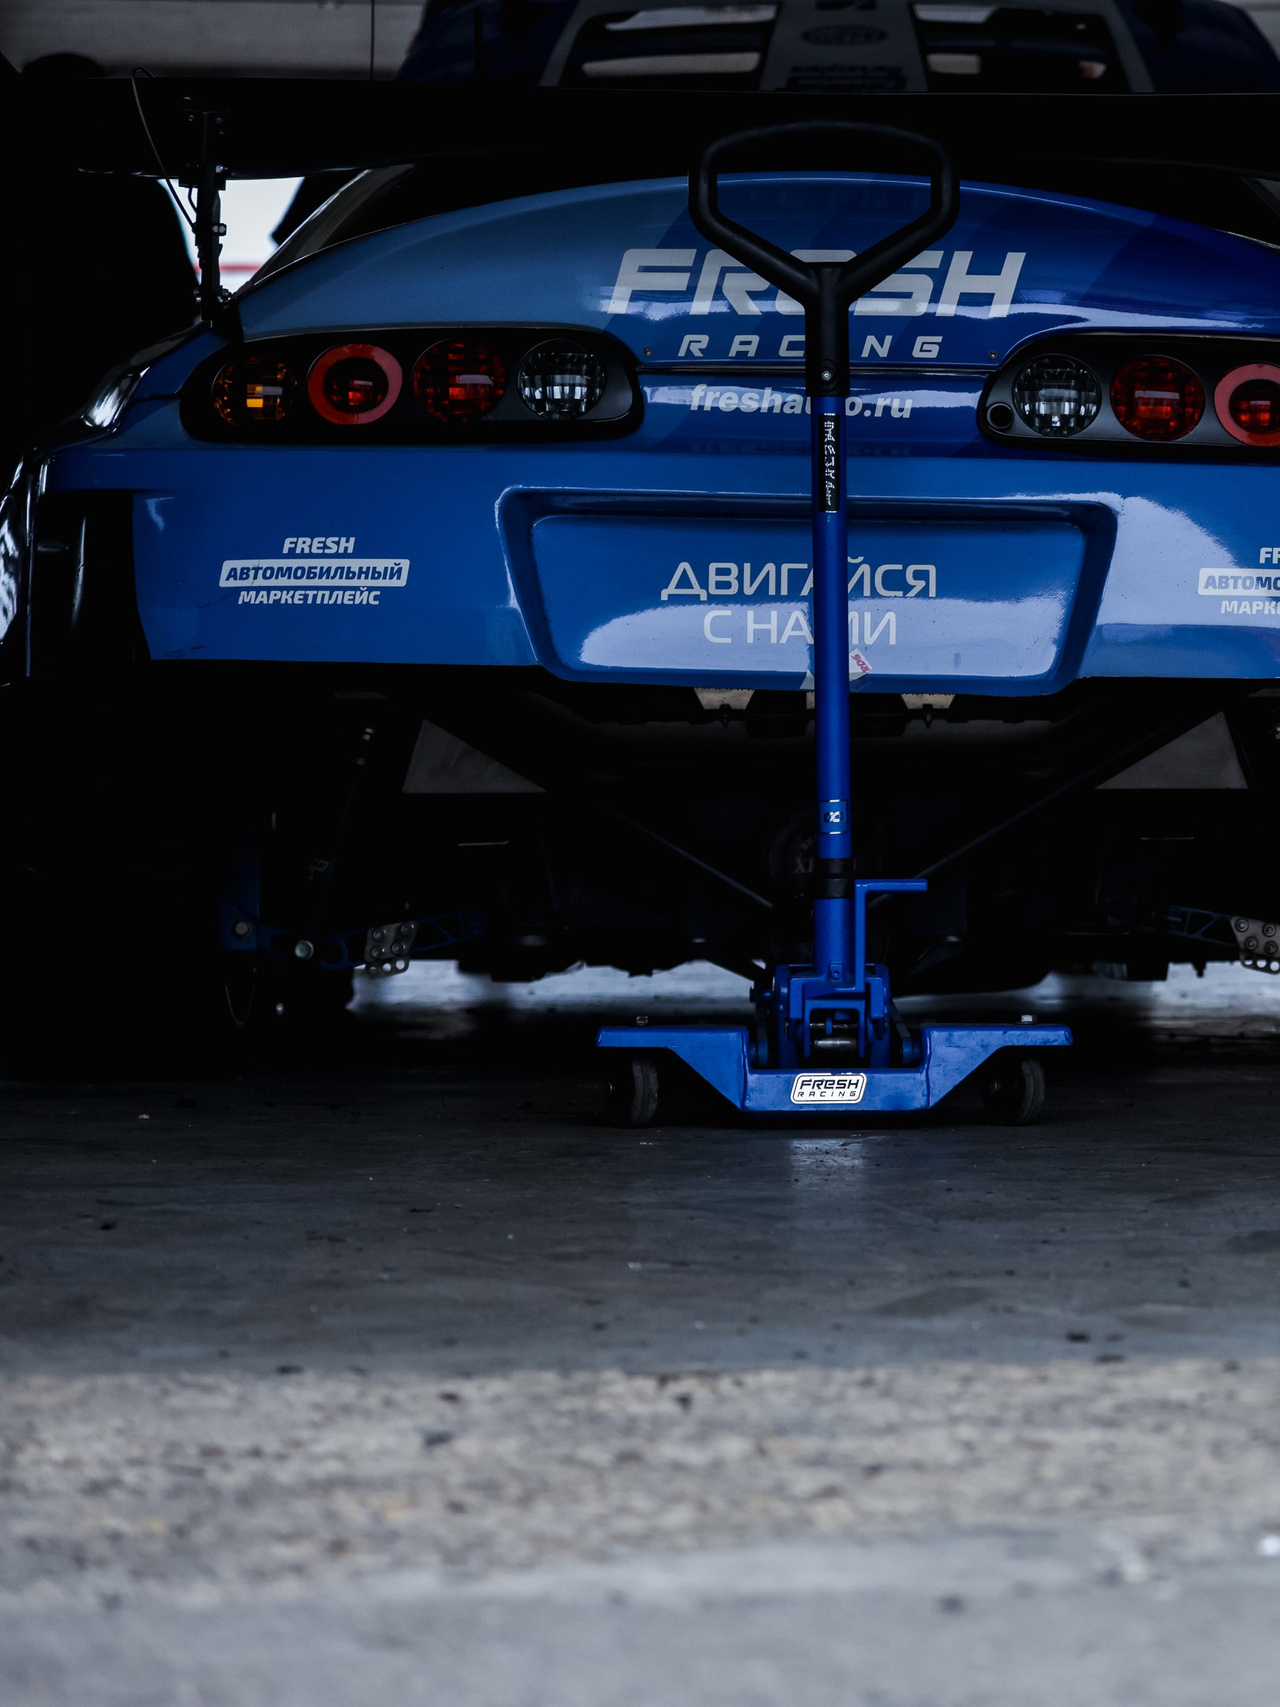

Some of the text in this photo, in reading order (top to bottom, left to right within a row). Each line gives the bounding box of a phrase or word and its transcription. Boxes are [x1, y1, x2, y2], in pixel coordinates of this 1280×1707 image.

[677, 334, 944, 359] RACNG
[690, 383, 913, 419] freshao.ru
[282, 536, 356, 554] FRESH
[225, 562, 403, 581] АВТОМОБИЛЬНЫЙ
[238, 587, 381, 605] МАРКЕТПЛЕЙС
[703, 610, 732, 643] С
